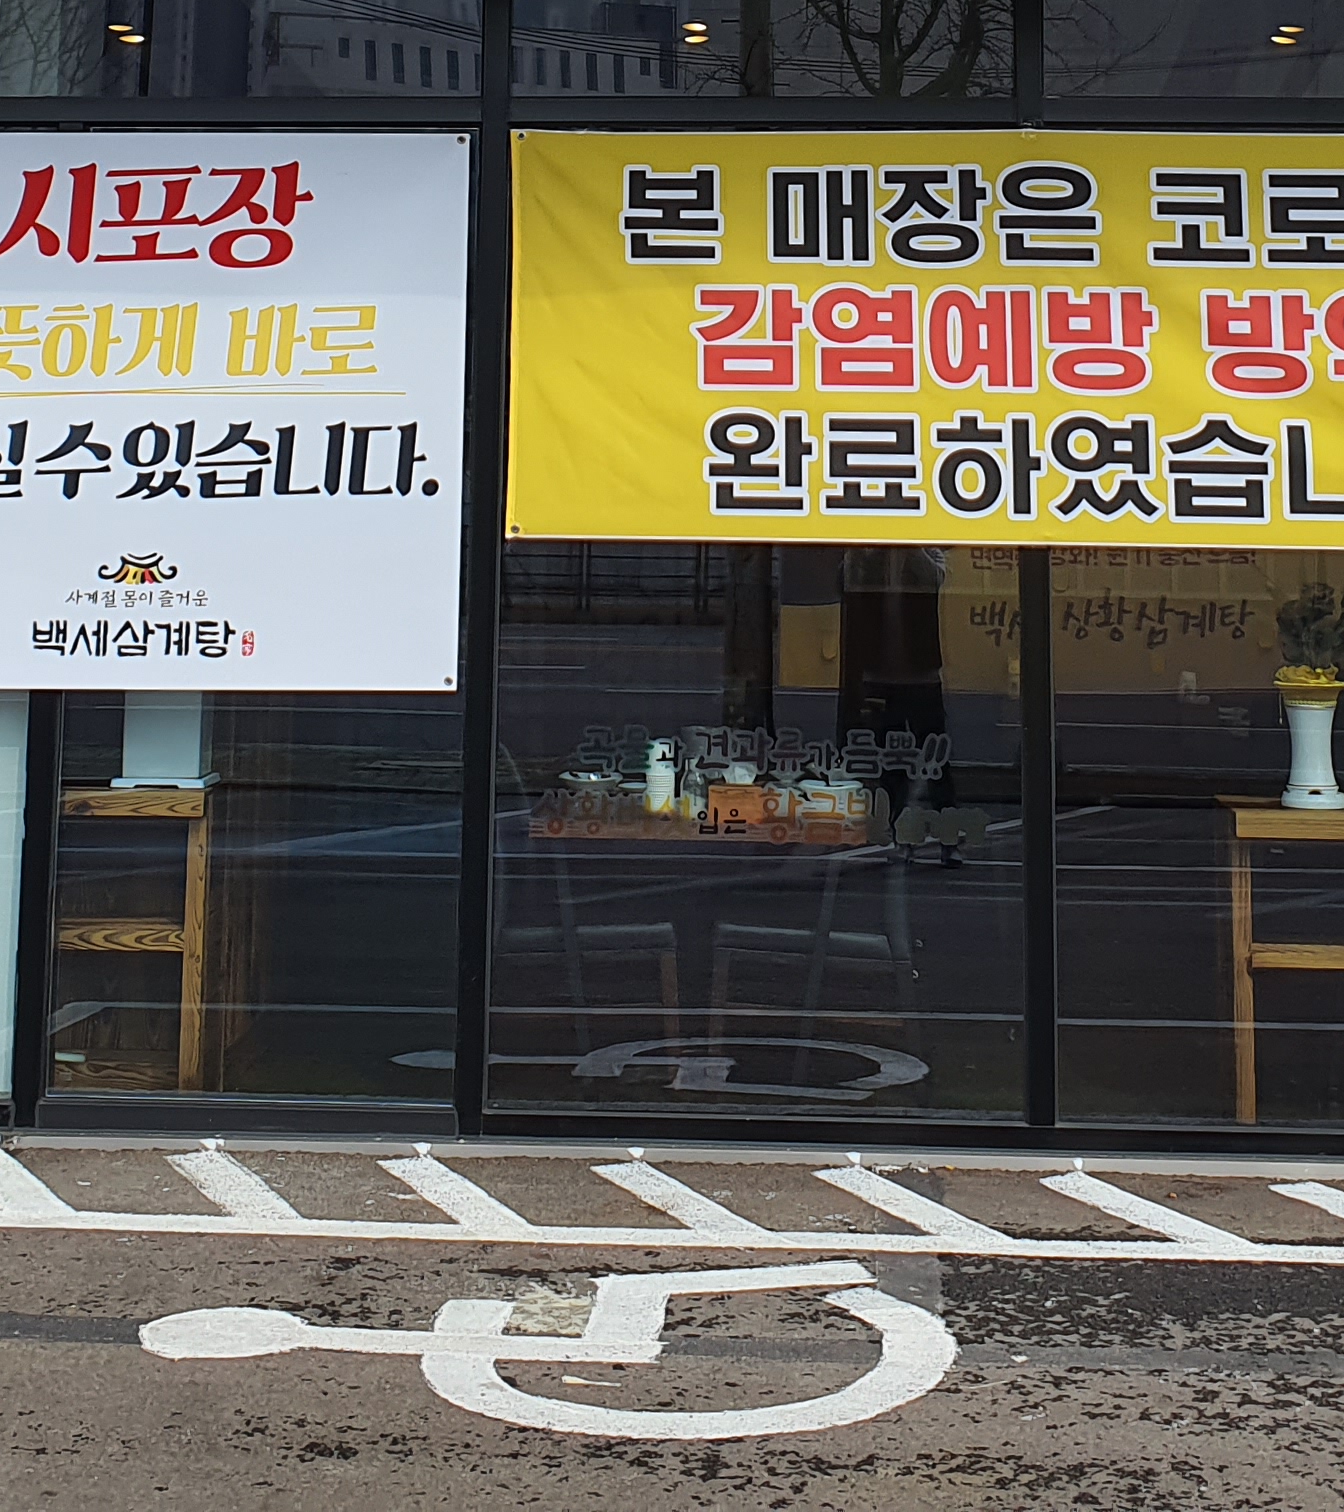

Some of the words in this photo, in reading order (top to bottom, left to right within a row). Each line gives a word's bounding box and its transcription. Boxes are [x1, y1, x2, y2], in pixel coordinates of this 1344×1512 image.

[622, 164, 722, 263] 본
[770, 162, 1100, 265] 매장은
[225, 302, 379, 377] 바로
[693, 285, 1156, 393] 감염예방
[64, 589, 118, 608] 사계절
[120, 590, 154, 608] 몸이
[157, 589, 209, 608] 즐거운
[32, 619, 236, 658] 백세삼계탕
